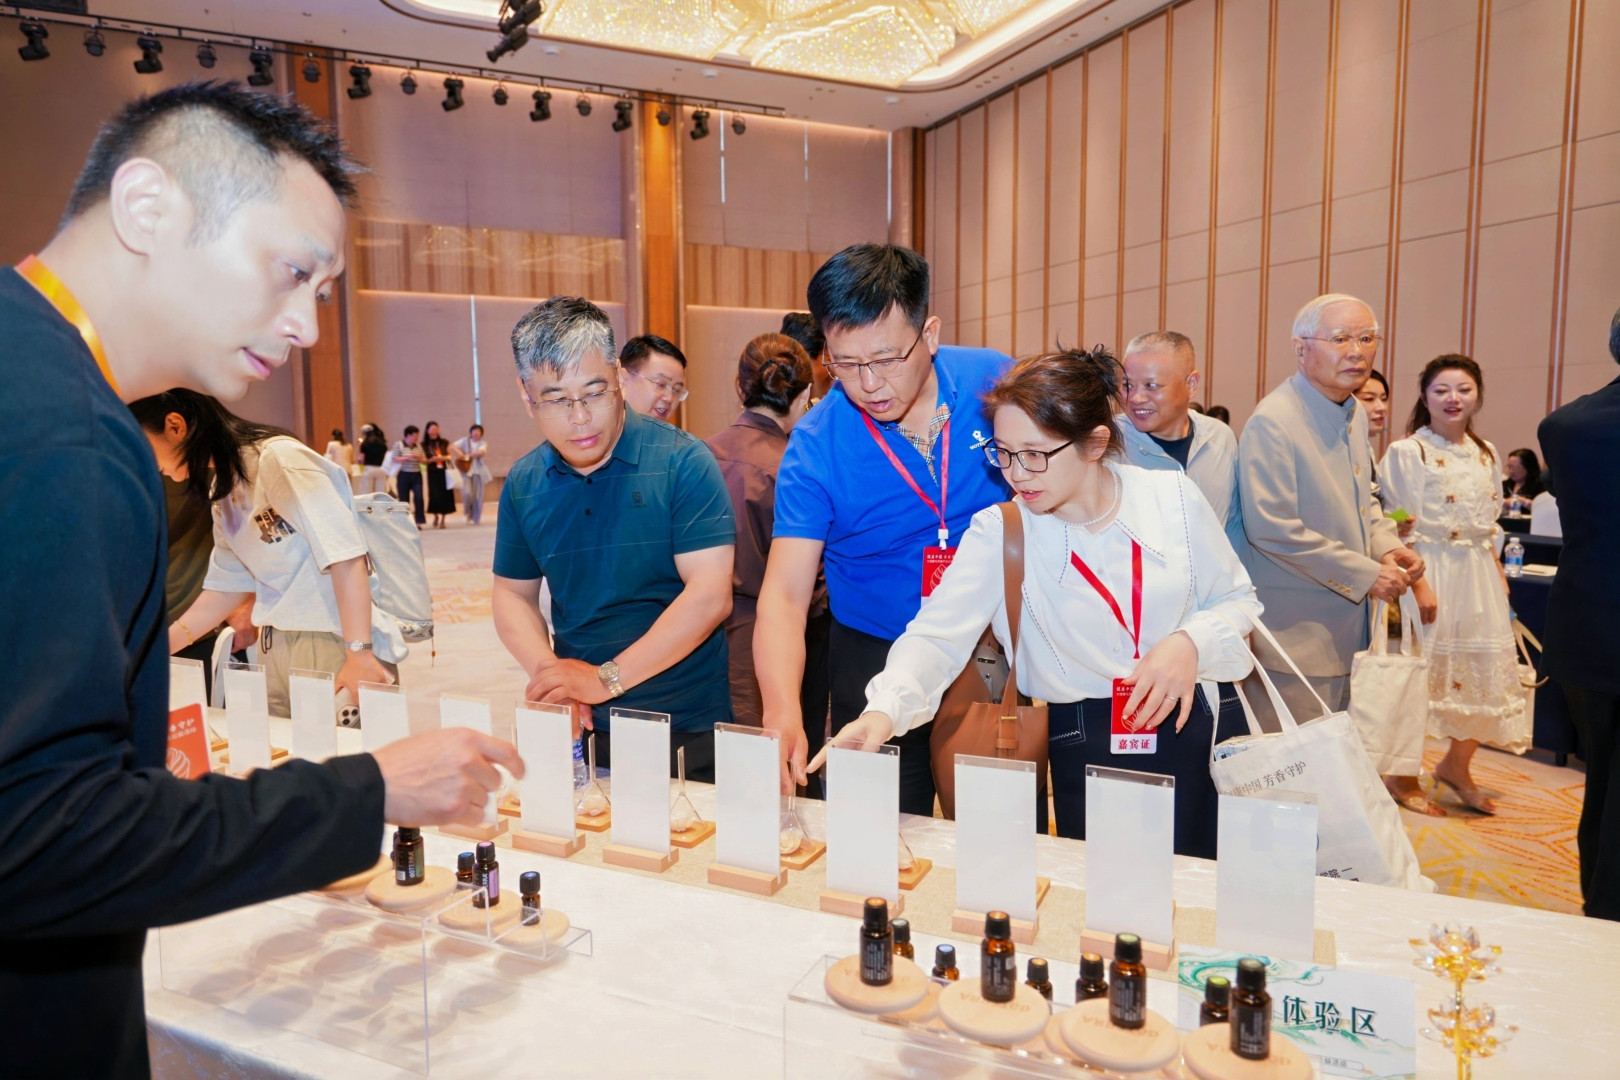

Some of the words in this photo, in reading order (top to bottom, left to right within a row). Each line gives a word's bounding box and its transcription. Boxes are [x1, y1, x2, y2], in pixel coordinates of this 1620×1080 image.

[1118, 739, 1150, 750] 嘉宾证
[1263, 761, 1306, 788] 芳香守护
[1283, 995, 1376, 1037] 体验区
